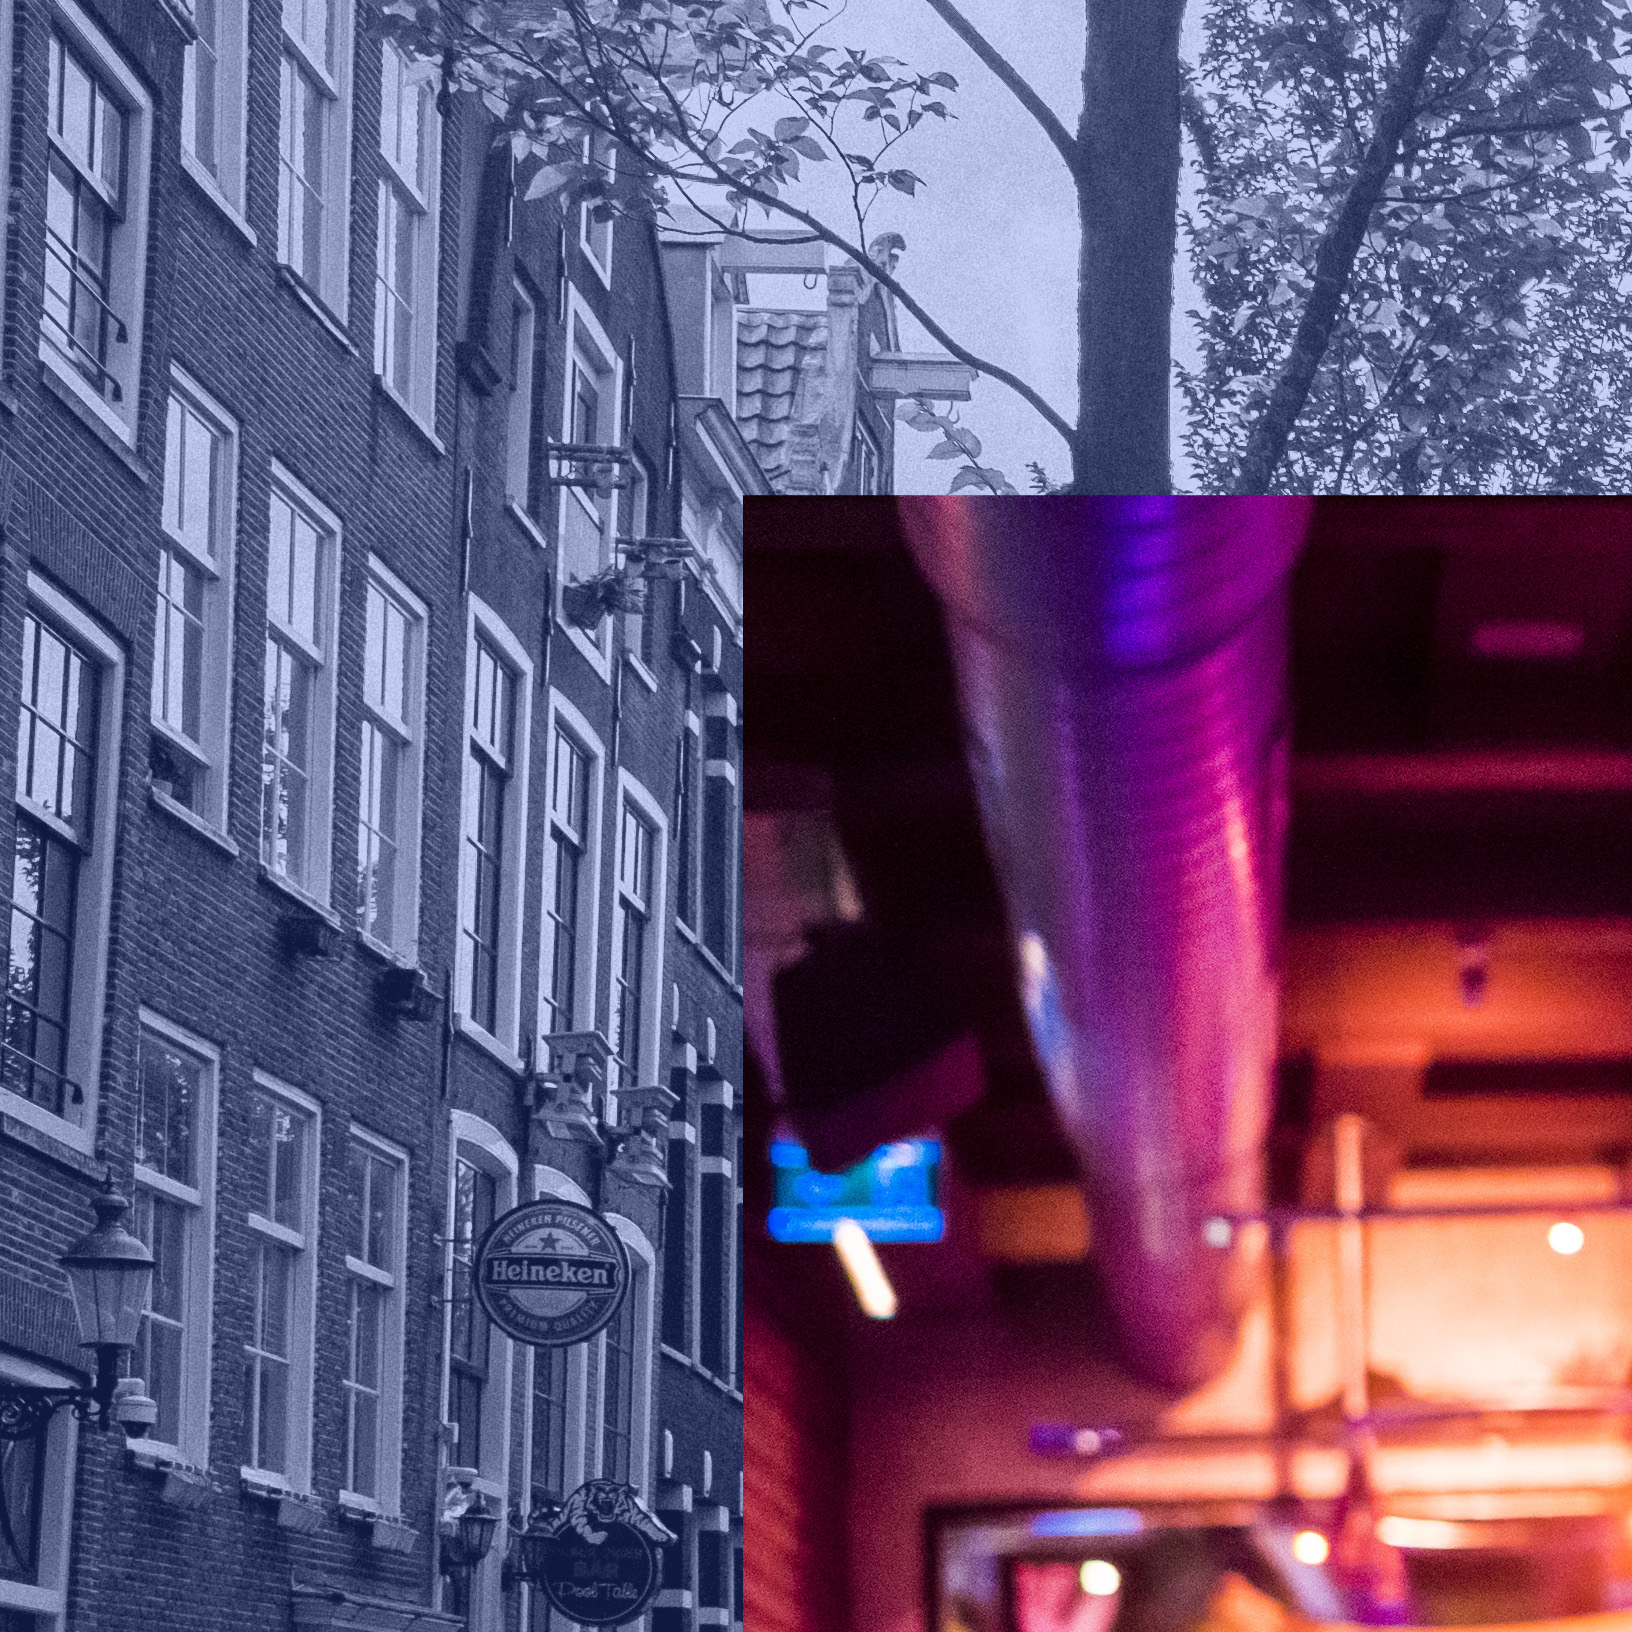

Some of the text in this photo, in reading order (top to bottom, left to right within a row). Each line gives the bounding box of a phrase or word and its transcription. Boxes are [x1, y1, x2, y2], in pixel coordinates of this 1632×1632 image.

[502, 1214, 601, 1246] HEINEKEN PILSENER
[491, 1260, 609, 1285] Heineken
[500, 1299, 600, 1331] PREMIUM QUALITY
